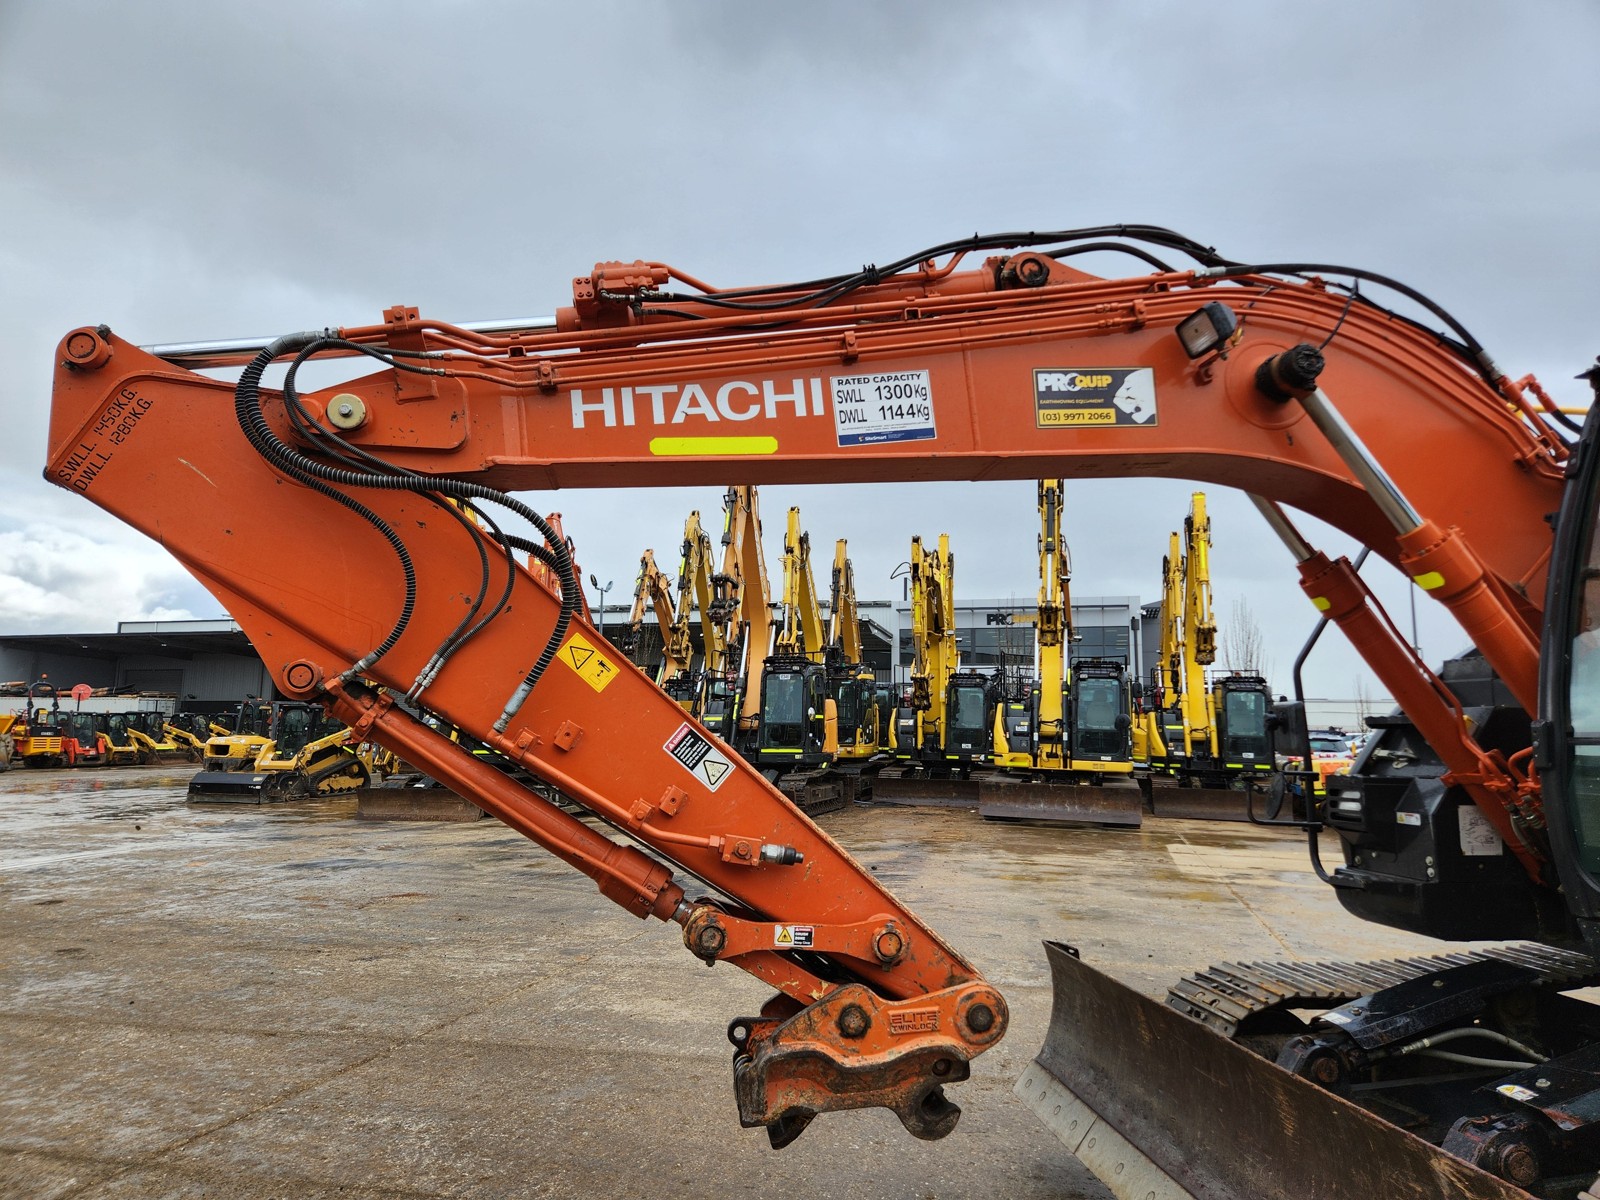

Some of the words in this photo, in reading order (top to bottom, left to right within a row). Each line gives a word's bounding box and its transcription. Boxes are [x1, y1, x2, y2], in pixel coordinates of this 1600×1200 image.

[838, 377, 870, 386] RATED
[873, 373, 921, 383] CAPACITY
[570, 378, 824, 428] HITACHI
[836, 388, 866, 404] SWLL
[838, 408, 868, 424] DWLL
[1042, 412, 1060, 422] (03)
[58, 443, 97, 482] S.W.L.L.
[73, 452, 113, 492] D.W.L.L.
[673, 727, 688, 744] DANGER
[892, 1012, 937, 1023] ELITE
[892, 1022, 938, 1031] TWINLOCK
